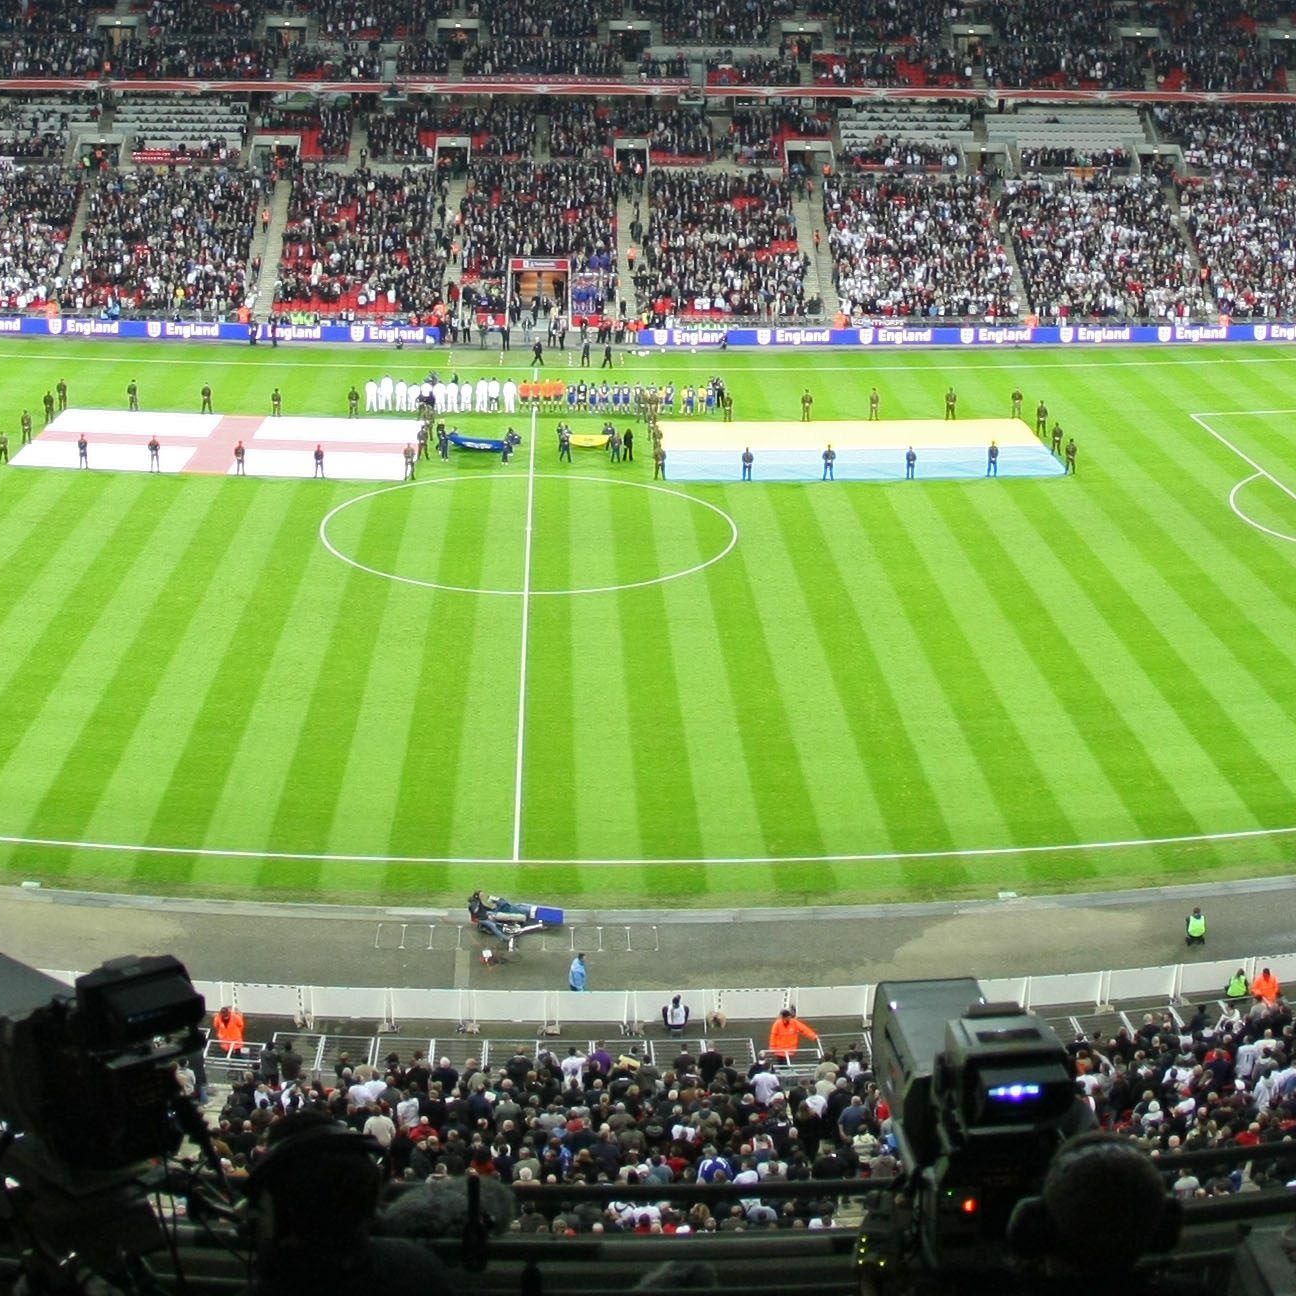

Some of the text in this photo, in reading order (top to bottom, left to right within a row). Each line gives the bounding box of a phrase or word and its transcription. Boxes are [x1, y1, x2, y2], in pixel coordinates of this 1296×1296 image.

[67, 319, 119, 336] England
[166, 322, 219, 339] England
[369, 326, 423, 342] England
[978, 327, 1031, 342] England
[1078, 326, 1130, 342] England
[1175, 325, 1226, 341] England
[776, 328, 830, 344] England
[878, 328, 931, 344] England
